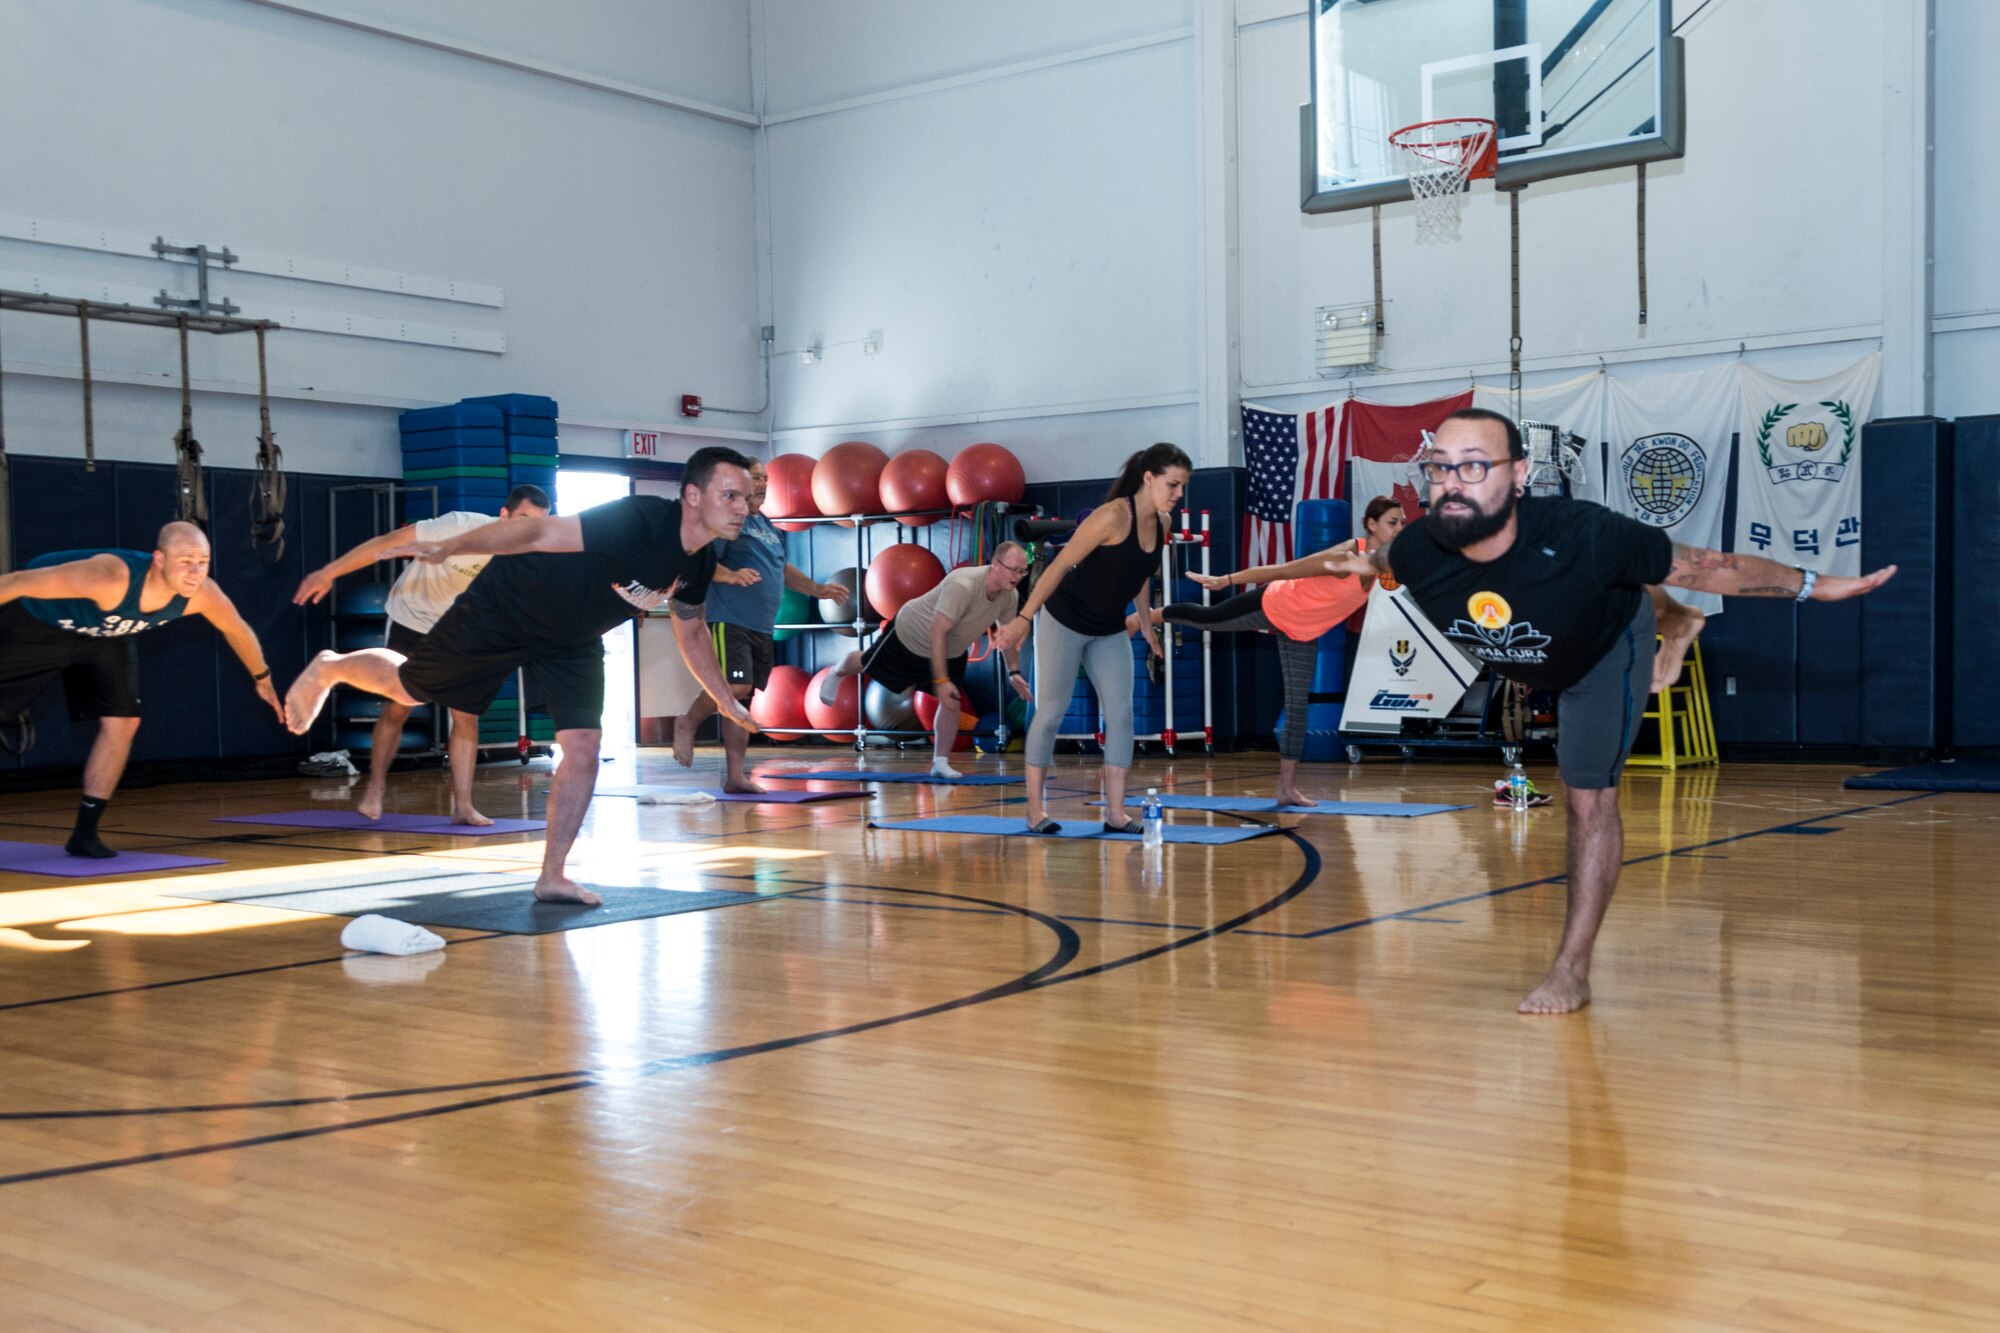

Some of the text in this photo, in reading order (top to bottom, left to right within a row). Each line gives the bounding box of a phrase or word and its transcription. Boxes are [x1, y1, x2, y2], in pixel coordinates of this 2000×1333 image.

[633, 432, 658, 456] EXIT
[1651, 436, 1678, 447] KWON
[1678, 439, 1690, 451] DO
[1506, 647, 1549, 659] CURA
[1369, 694, 1420, 707] GUN
